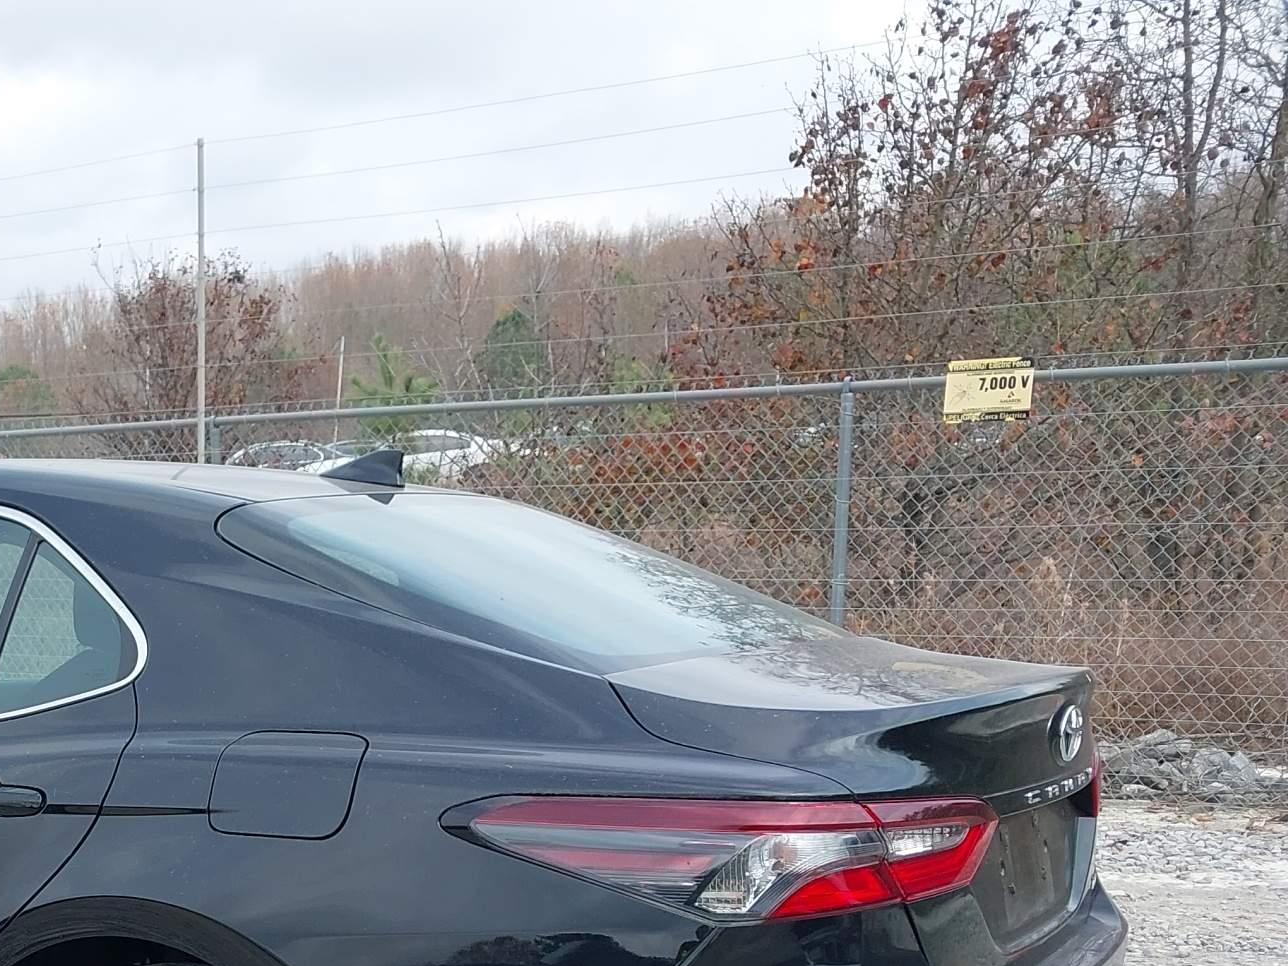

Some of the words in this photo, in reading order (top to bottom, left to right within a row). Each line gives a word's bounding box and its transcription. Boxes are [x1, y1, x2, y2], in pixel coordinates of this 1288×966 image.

[1012, 360, 1031, 368] Fence
[979, 376, 1016, 392] 7,000
[1021, 375, 1030, 388] V
